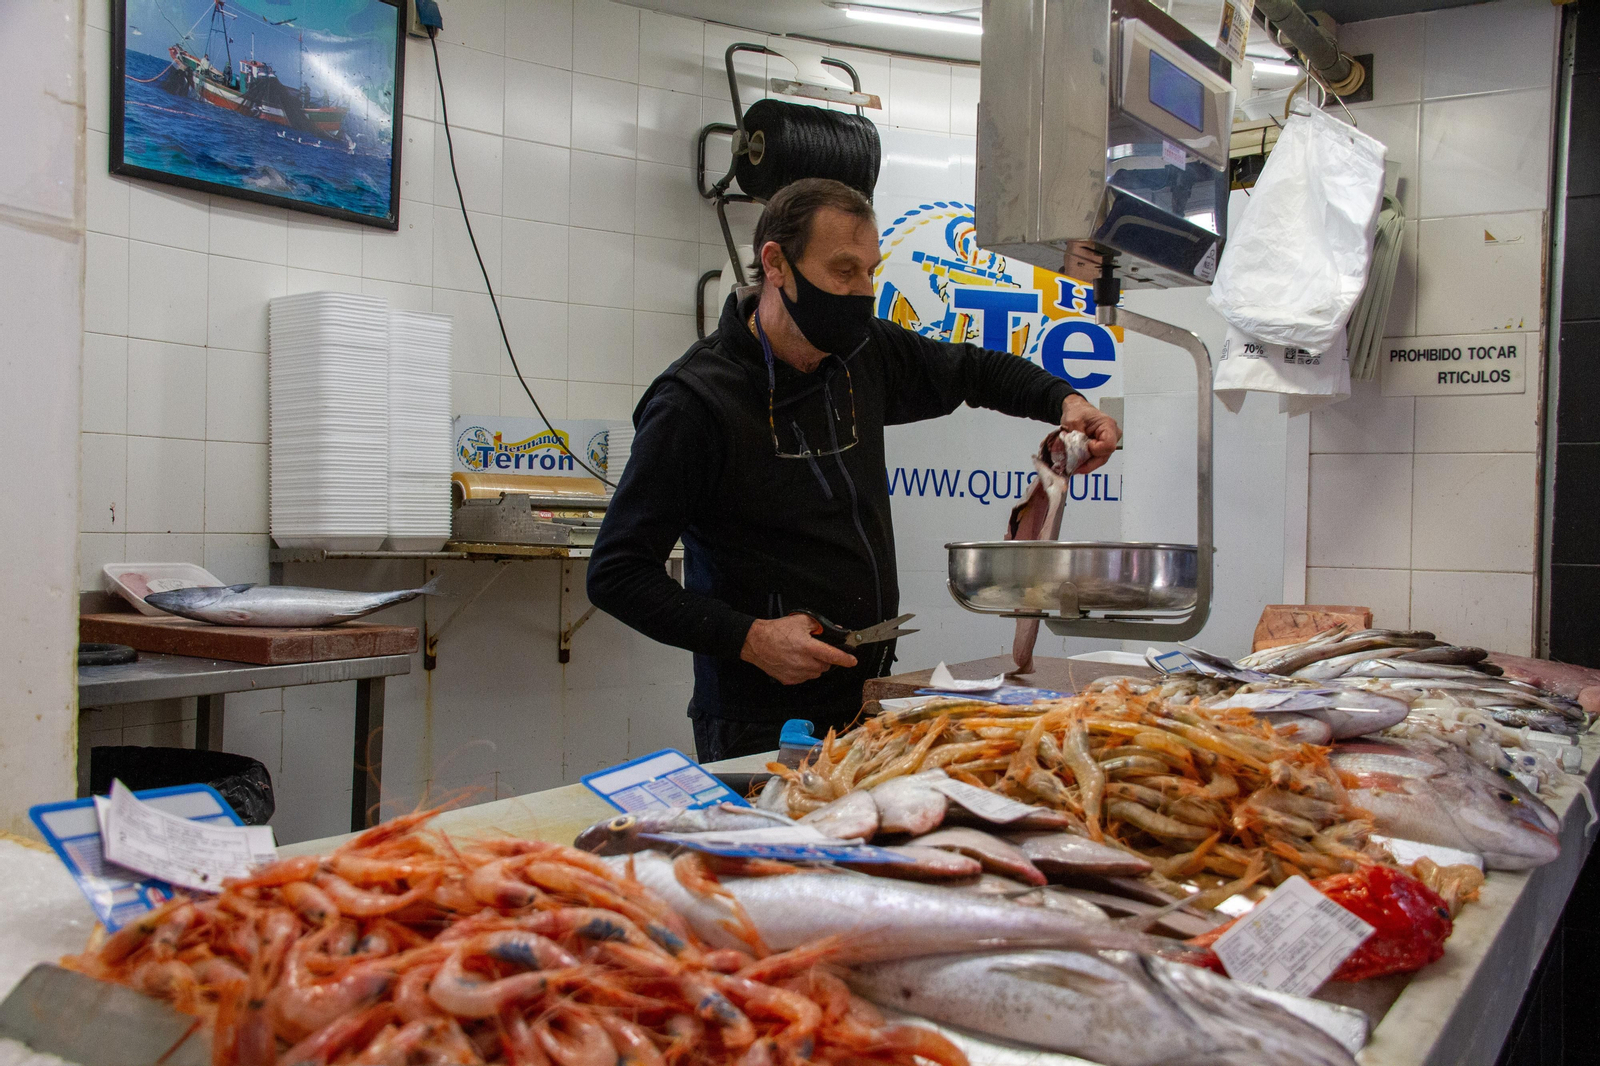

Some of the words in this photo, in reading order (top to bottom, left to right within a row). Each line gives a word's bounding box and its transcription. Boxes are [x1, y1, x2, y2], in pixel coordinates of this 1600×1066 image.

[1244, 343, 1264, 355] 70%
[1390, 347, 1462, 362] PROHIBIDO
[1468, 345, 1517, 360] TOCAR
[476, 446, 574, 471] Terrón
